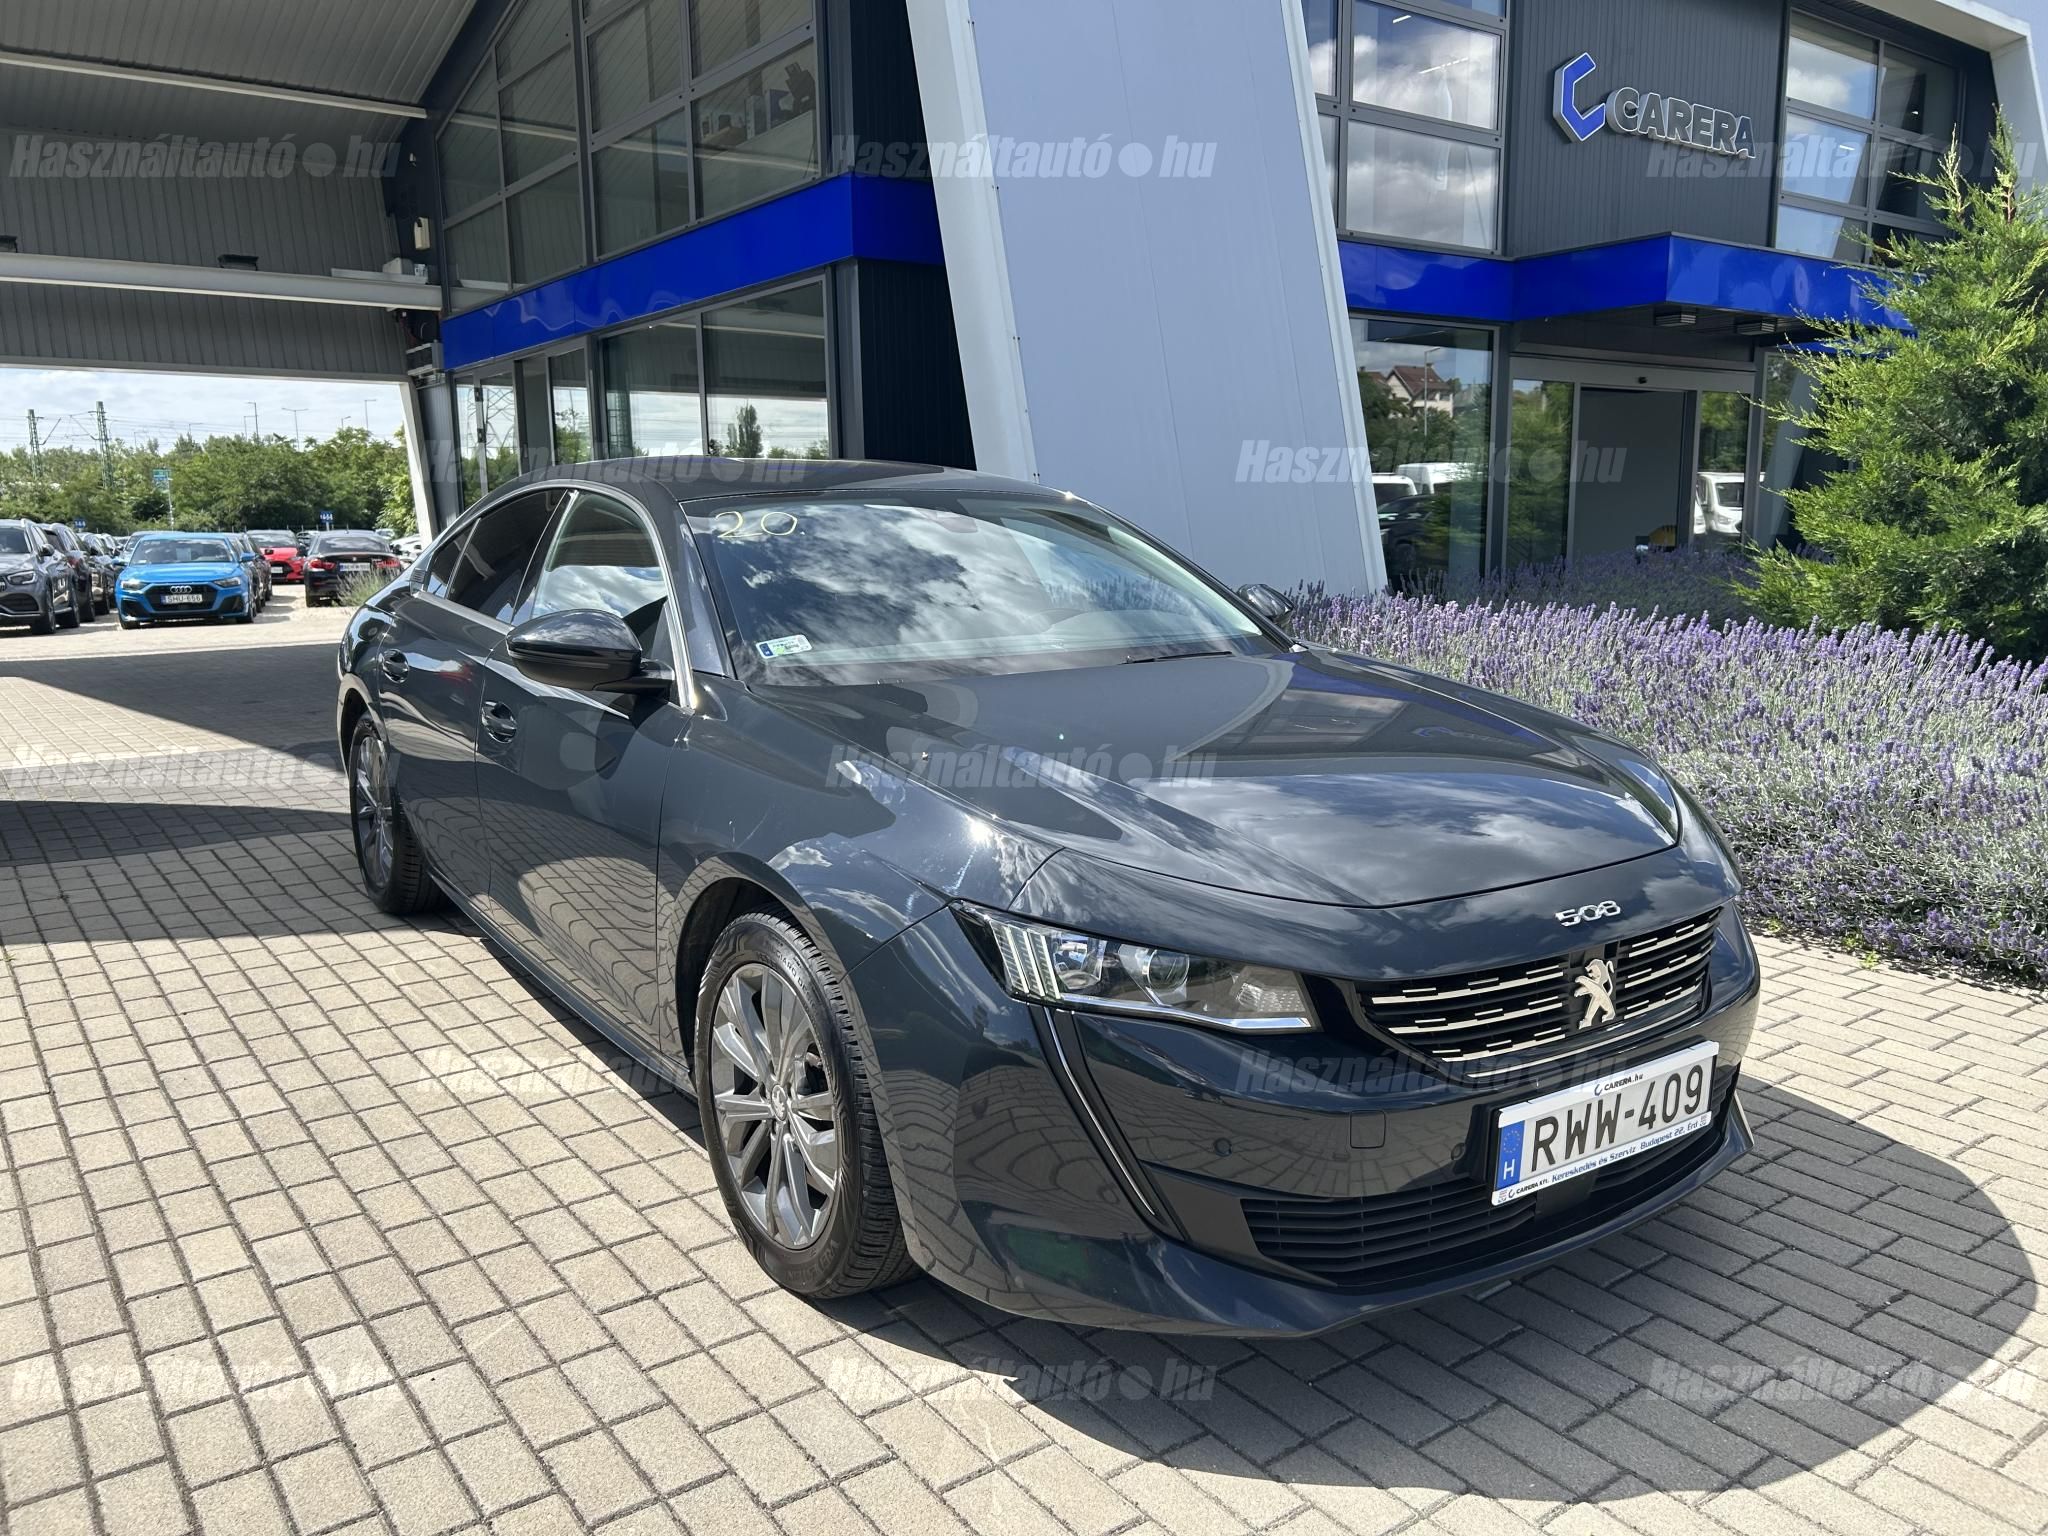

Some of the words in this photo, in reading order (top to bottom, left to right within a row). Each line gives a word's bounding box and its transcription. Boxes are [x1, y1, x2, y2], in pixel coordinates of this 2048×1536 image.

[1607, 87, 1756, 158] CARERA
[714, 511, 798, 538] 20
[1555, 900, 1621, 927] 508
[1503, 1158, 1515, 1180] H
[1531, 1064, 1703, 1172] RWW-409
